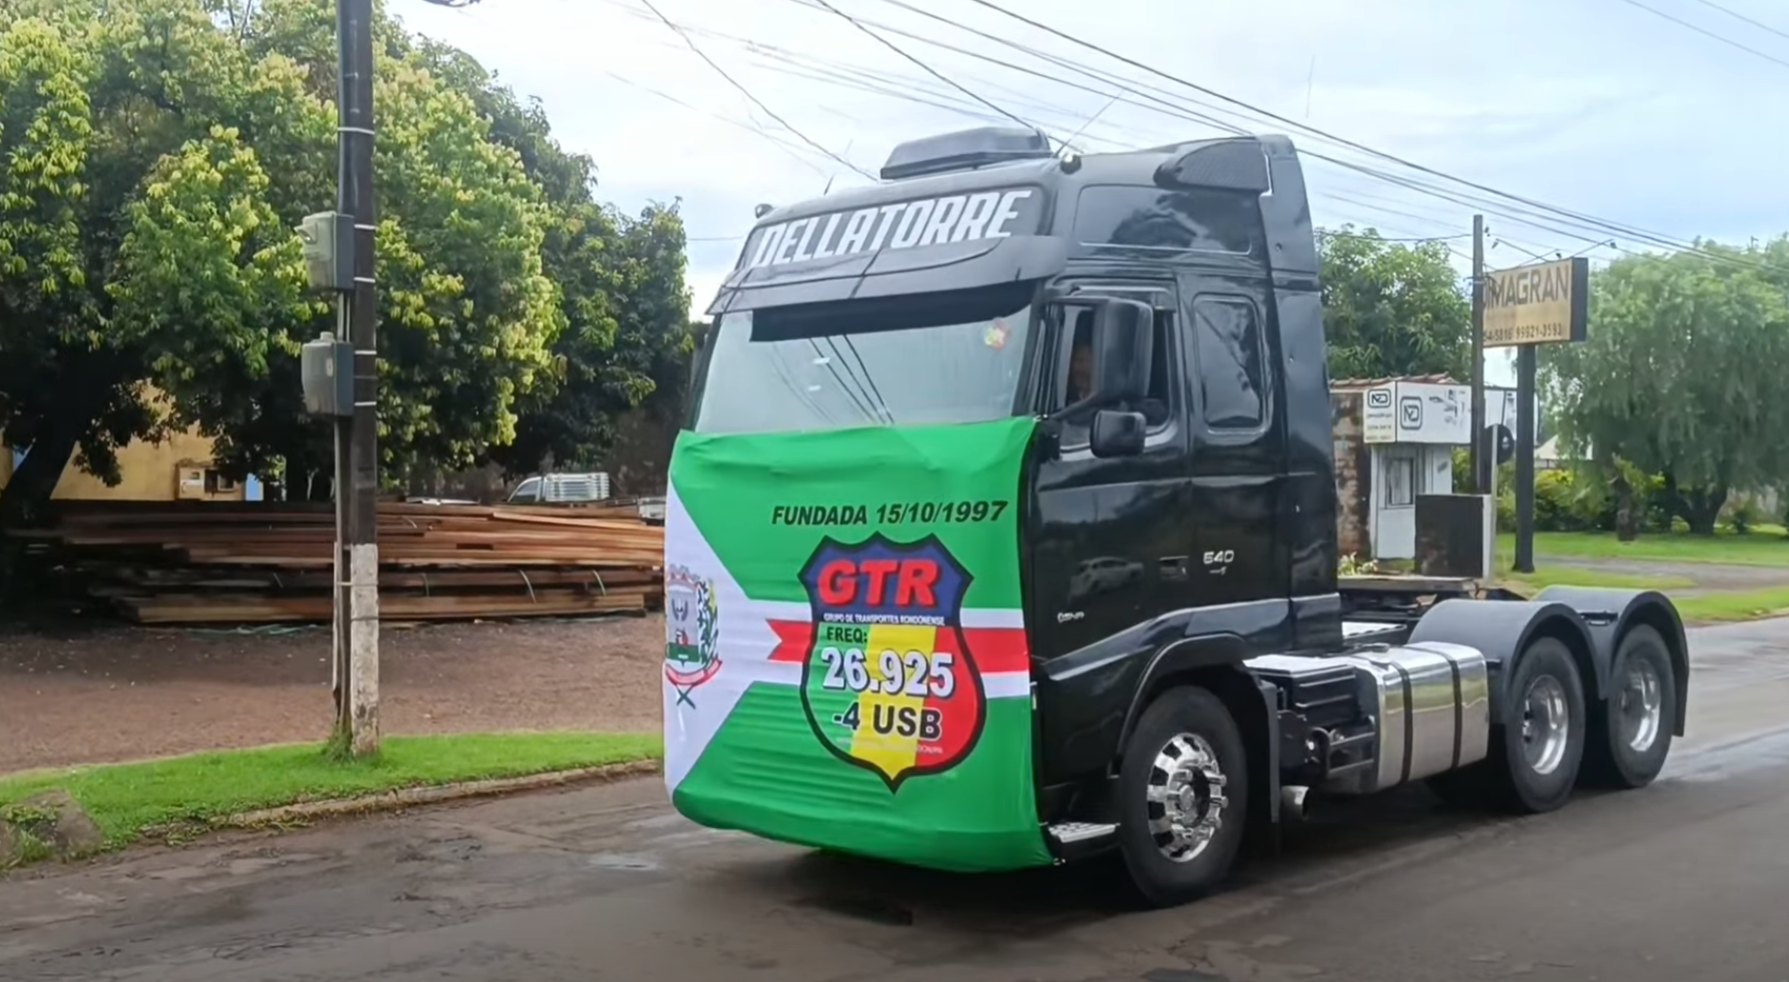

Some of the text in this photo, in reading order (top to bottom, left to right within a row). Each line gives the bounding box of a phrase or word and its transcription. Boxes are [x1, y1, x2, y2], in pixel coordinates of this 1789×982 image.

[751, 190, 1032, 268] DELLATORRE
[771, 500, 1008, 525] FUNDADA 15/10/1997
[817, 558, 940, 608] GTR
[823, 612, 844, 622] GRUPO
[845, 613, 854, 623] DE
[854, 613, 899, 624] TRANSPORTES
[827, 626, 868, 644] FREQ:
[821, 646, 955, 699] 26.925
[833, 701, 942, 740] -4 USB
